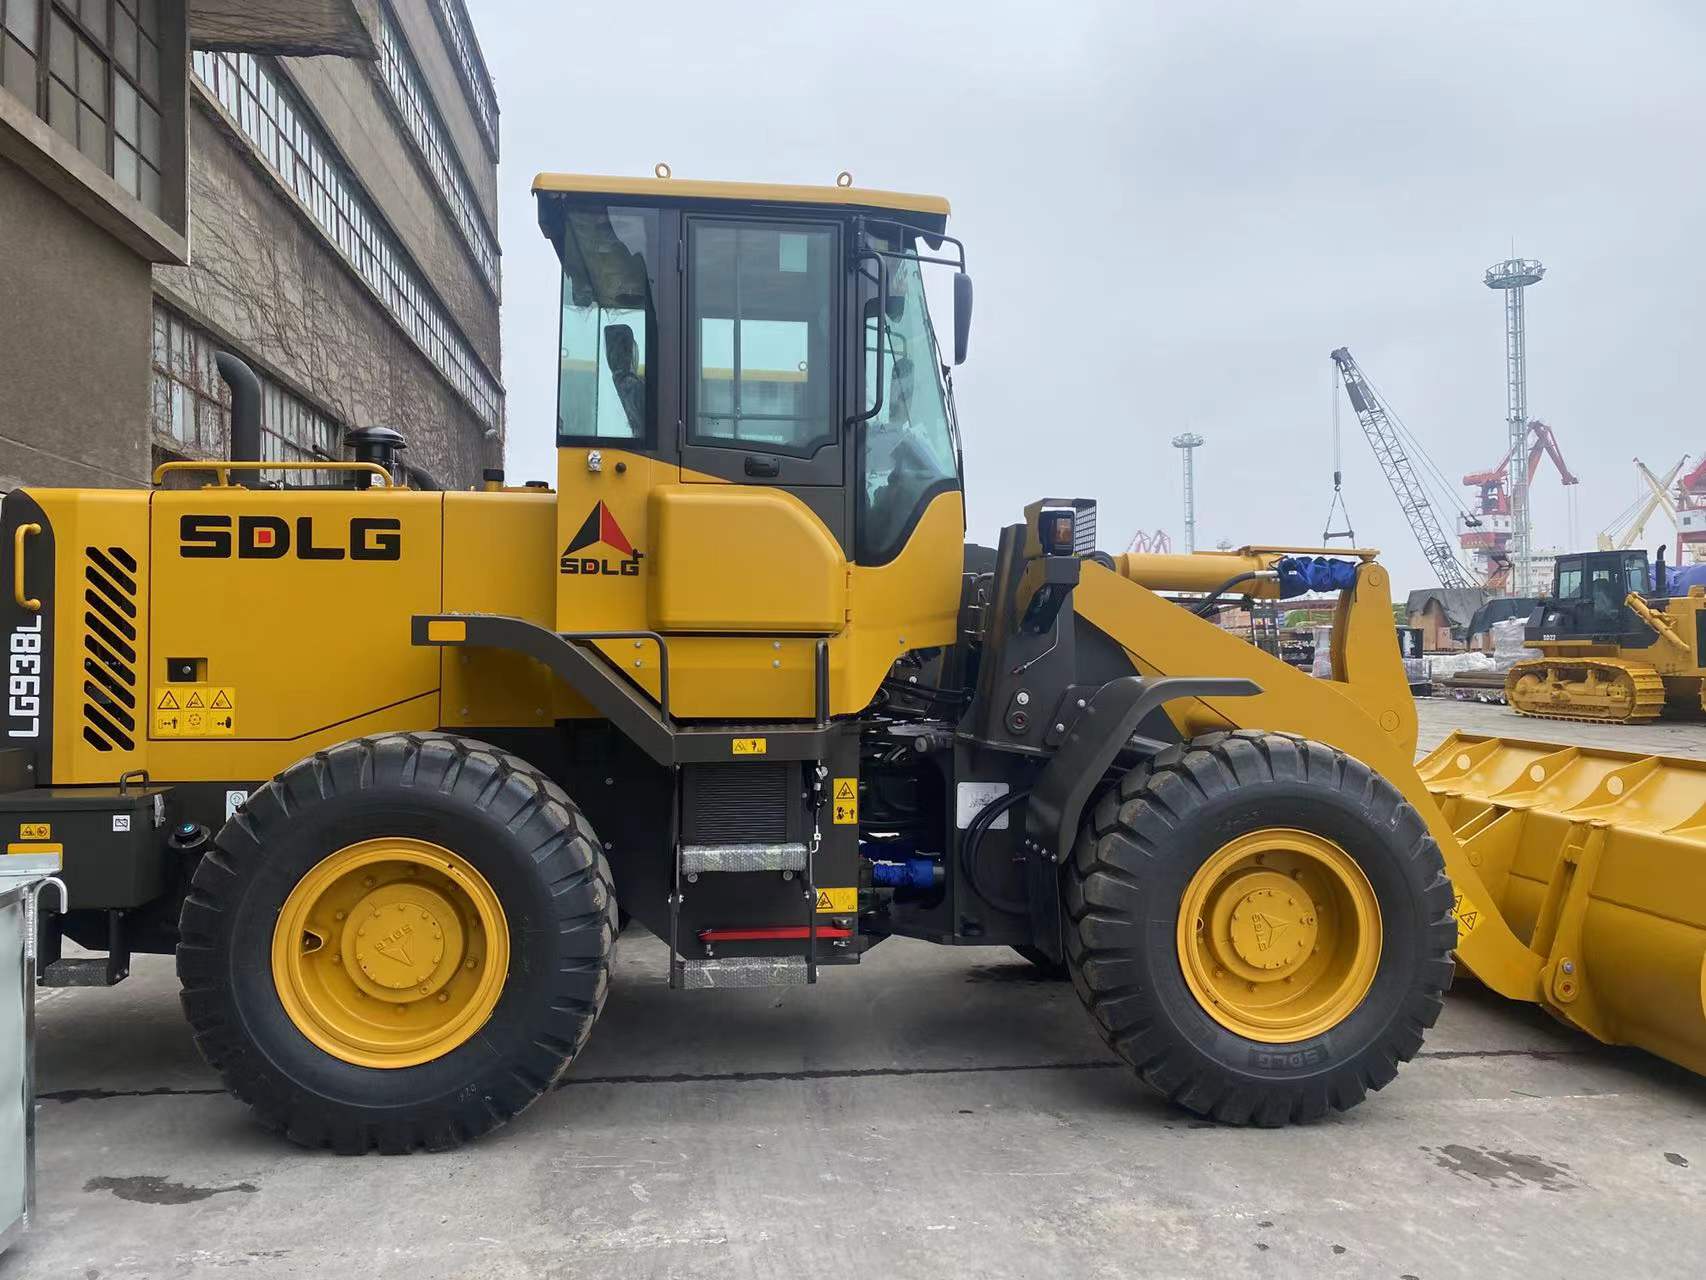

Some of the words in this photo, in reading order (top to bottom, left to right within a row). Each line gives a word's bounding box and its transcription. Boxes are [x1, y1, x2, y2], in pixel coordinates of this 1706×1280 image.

[180, 515, 401, 561] SDLG
[560, 558, 640, 576] SDLG
[8, 615, 42, 737] LG938L
[374, 923, 414, 952] SDLG
